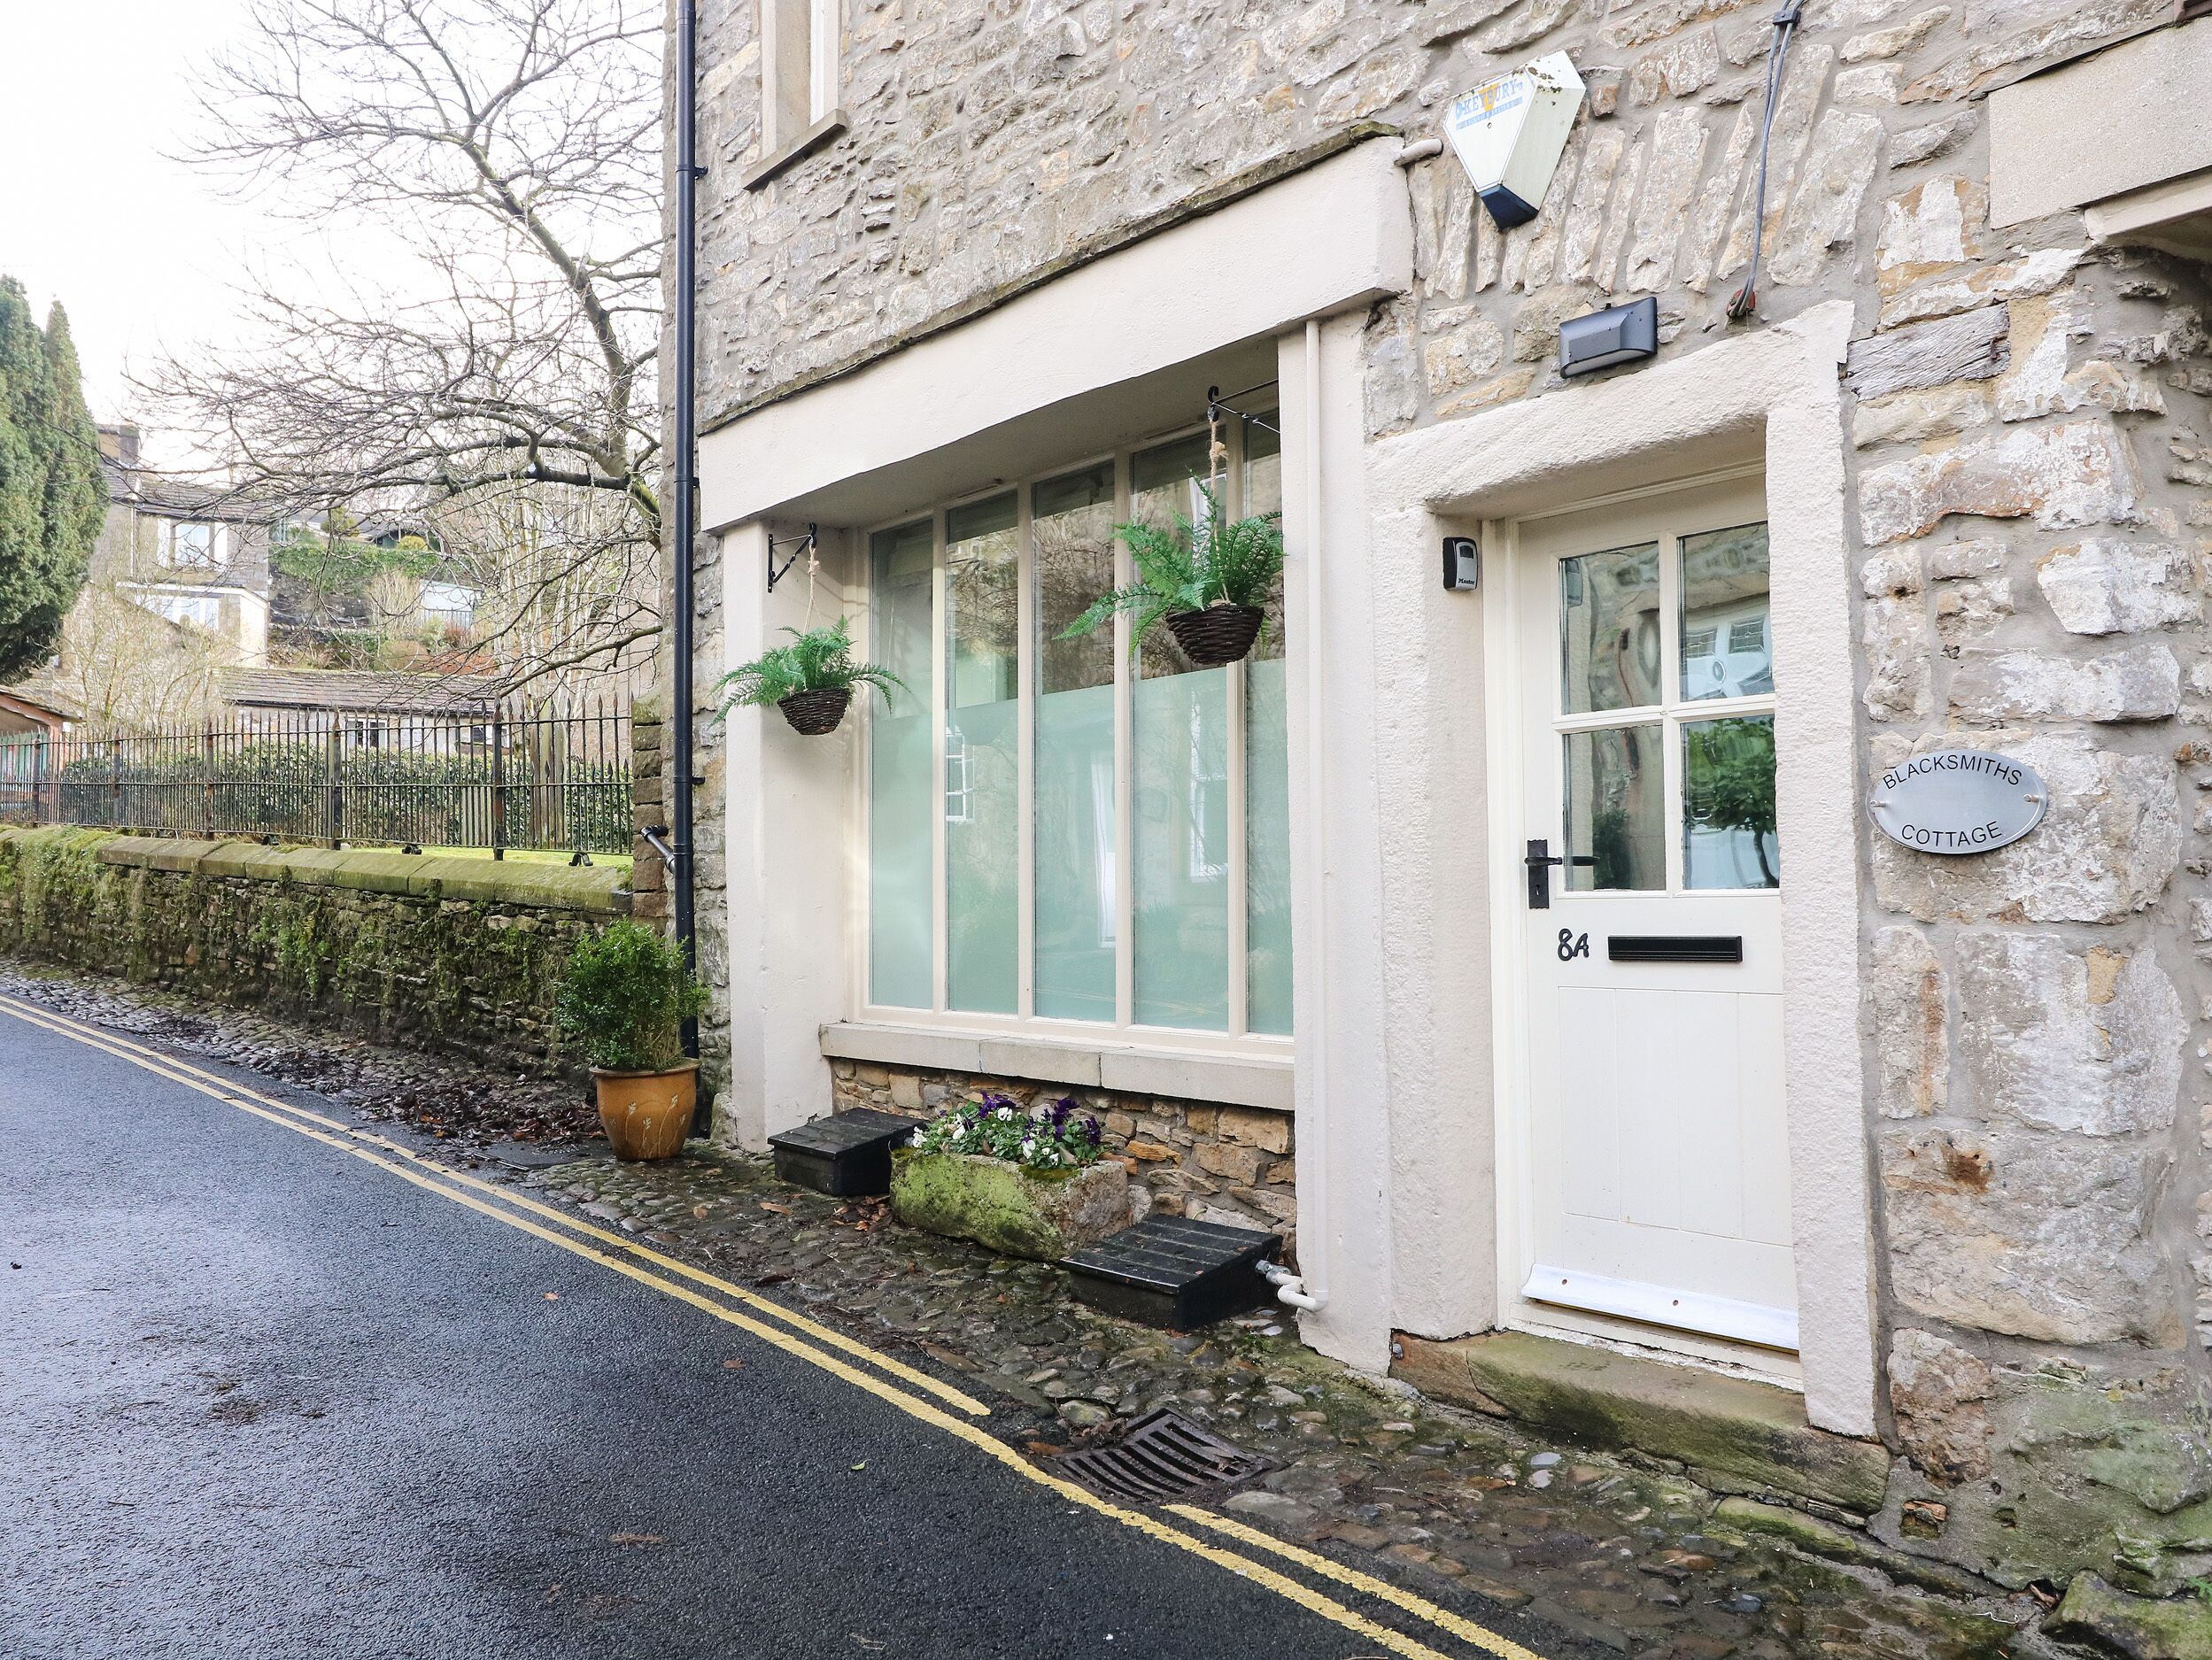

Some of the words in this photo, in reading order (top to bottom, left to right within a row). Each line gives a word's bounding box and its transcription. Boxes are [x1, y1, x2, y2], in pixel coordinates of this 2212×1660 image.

[1883, 754, 2023, 790] BLACKSMITHS
[1901, 821, 2002, 847] COTTAGE
[1557, 928, 1589, 961] 8A
